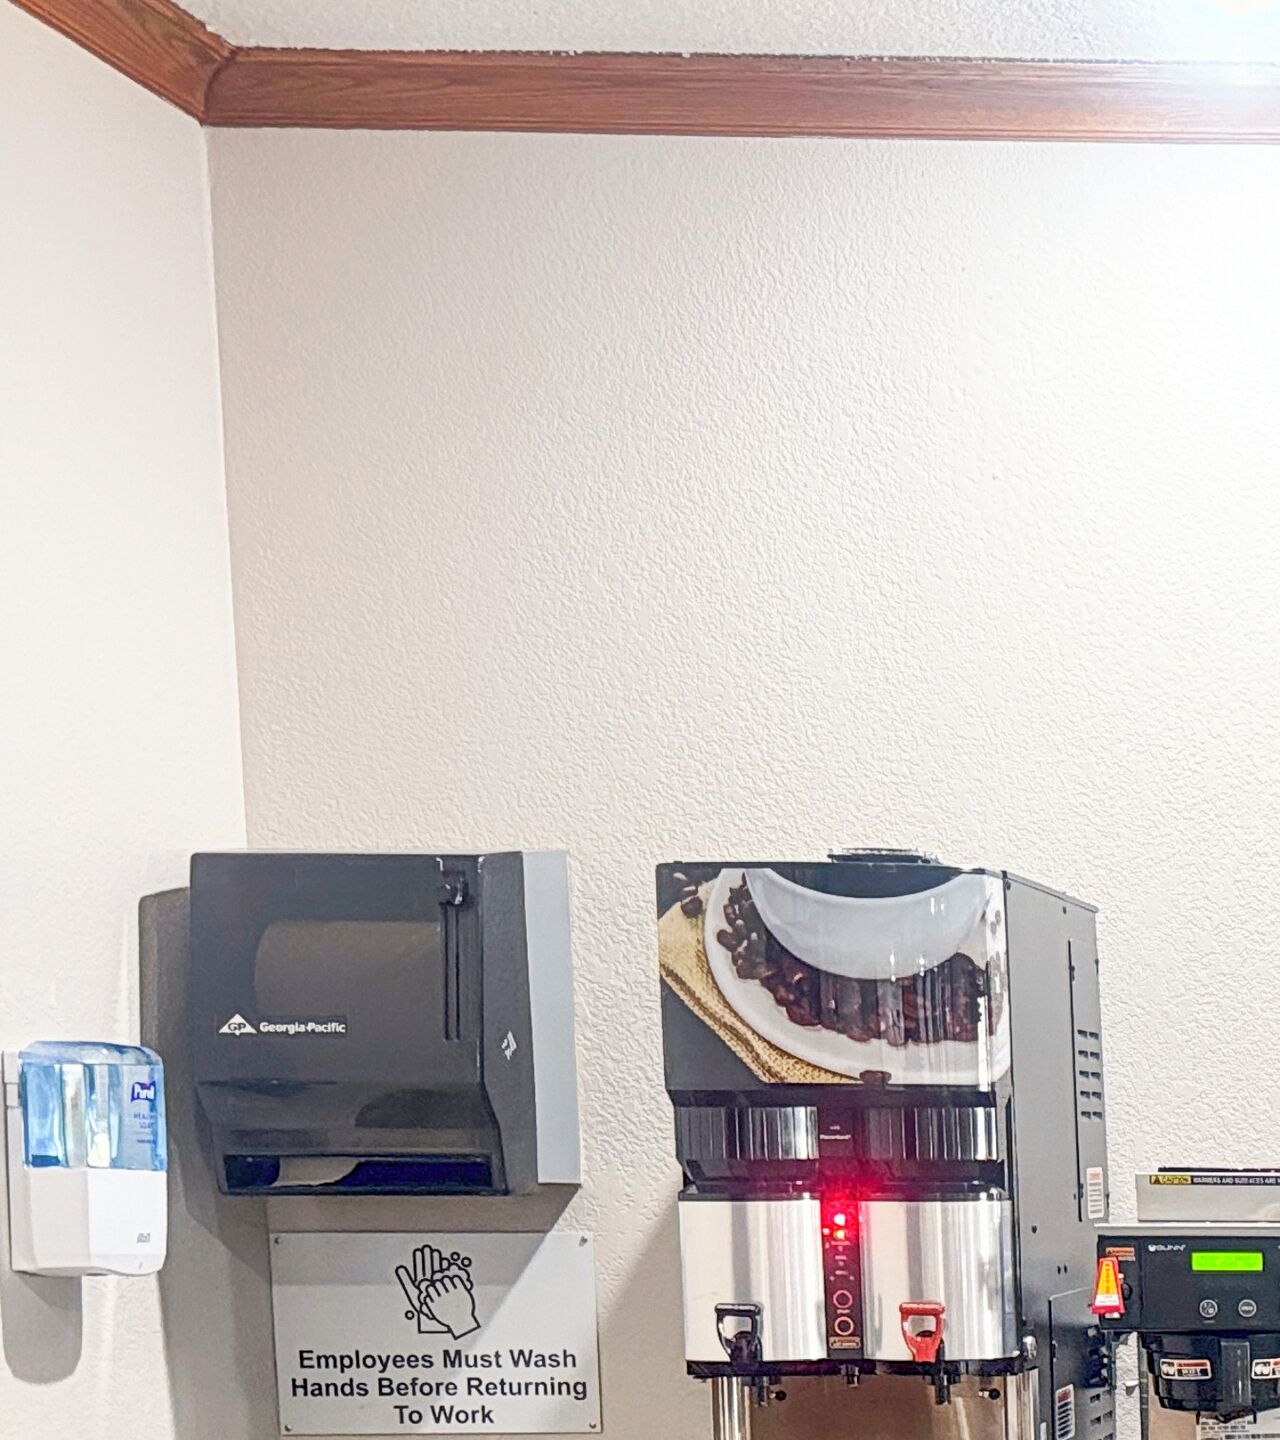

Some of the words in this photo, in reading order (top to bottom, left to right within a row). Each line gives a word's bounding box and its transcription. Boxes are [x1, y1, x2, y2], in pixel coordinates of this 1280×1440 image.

[299, 1349, 434, 1373] Employees
[443, 1349, 502, 1369] Must
[509, 1349, 577, 1369] Wash
[291, 1377, 370, 1397] Hands
[378, 1377, 458, 1397] Before
[466, 1376, 587, 1401] Returning
[394, 1405, 423, 1425] To
[430, 1404, 495, 1425] Work
